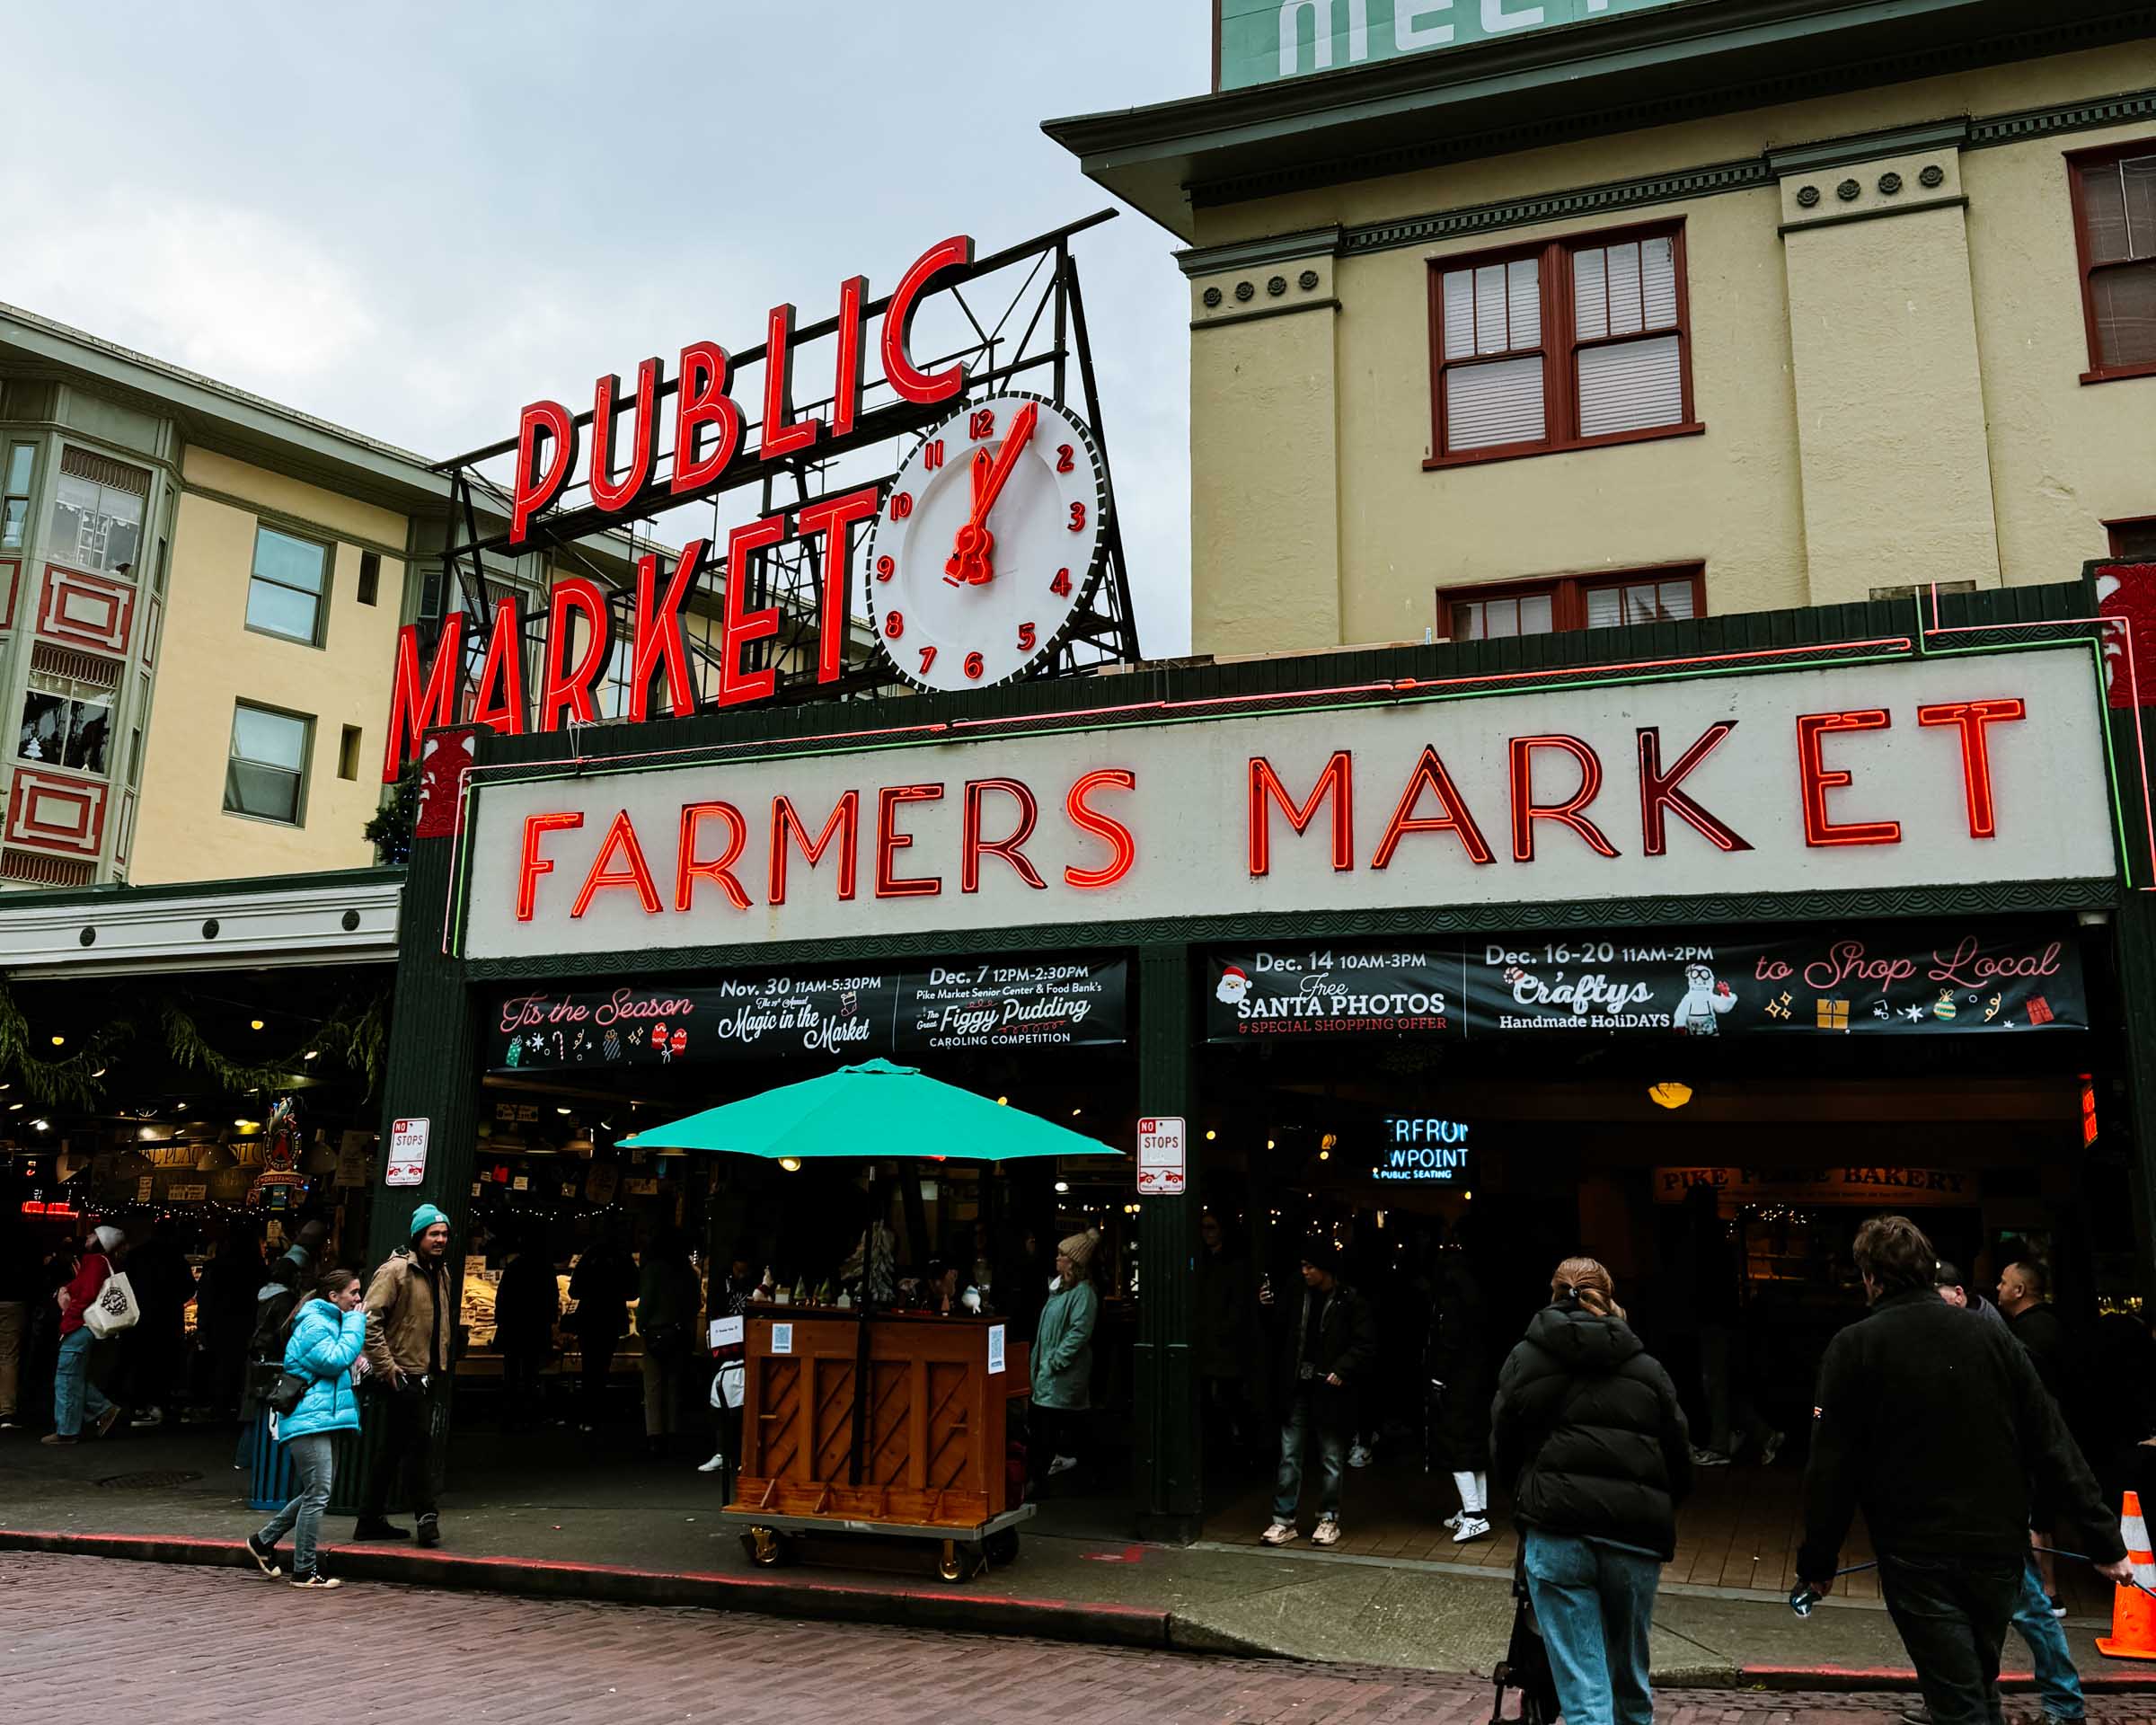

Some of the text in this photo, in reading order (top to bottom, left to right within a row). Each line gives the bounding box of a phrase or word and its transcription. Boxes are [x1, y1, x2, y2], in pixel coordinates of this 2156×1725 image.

[508, 234, 975, 544] PUBLIC
[969, 409, 994, 439] 12
[924, 439, 943, 470] 11
[1056, 444, 1074, 473] 2
[890, 492, 913, 521] 10
[1067, 501, 1086, 532] 3
[876, 555, 894, 582] 9
[1049, 568, 1072, 597] 4
[382, 487, 879, 784] MARKET
[885, 611, 904, 639] 8
[1017, 623, 1036, 650] 5
[919, 646, 937, 675] 7
[964, 651, 984, 679] 6
[517, 697, 2025, 922] FARMERS MARKET
[1256, 951, 1427, 972] Dec. 14 10AM-3PM
[1486, 943, 1714, 965] Dec. 16-20 11AM-2PM
[1754, 935, 2061, 992] to Shop Local
[720, 977, 881, 997] Nov. 30 11AM-5:30PM
[930, 966, 1089, 986] Dec. 7 12PM-2:30PM
[1299, 972, 1348, 1001] Free
[916, 981, 1102, 1000] Pike Market Senior Center & Food Bank's
[548, 995, 589, 1022] the
[596, 988, 694, 1025] Season
[940, 996, 1091, 1035] Figgy Pudding
[1237, 993, 1445, 1019] SANTA PHOTOS
[719, 1004, 819, 1042] Magic in the
[803, 1014, 870, 1054] Market
[1239, 1017, 1447, 1033] & SPECIAL SHOPPING OFFER
[1499, 1013, 1670, 1029] Handmade HoliDAYS
[929, 1033, 1071, 1048] CAROLING COMPETITION
[395, 1123, 406, 1132] NO
[396, 1135, 423, 1146] STOPS
[1141, 1121, 1154, 1132] NO
[1144, 1137, 1179, 1148] STOPS
[1381, 1170, 1411, 1179] PUBLIC
[1413, 1169, 1452, 1179] SEATING
[1842, 1165, 1966, 1194] BAKERY
